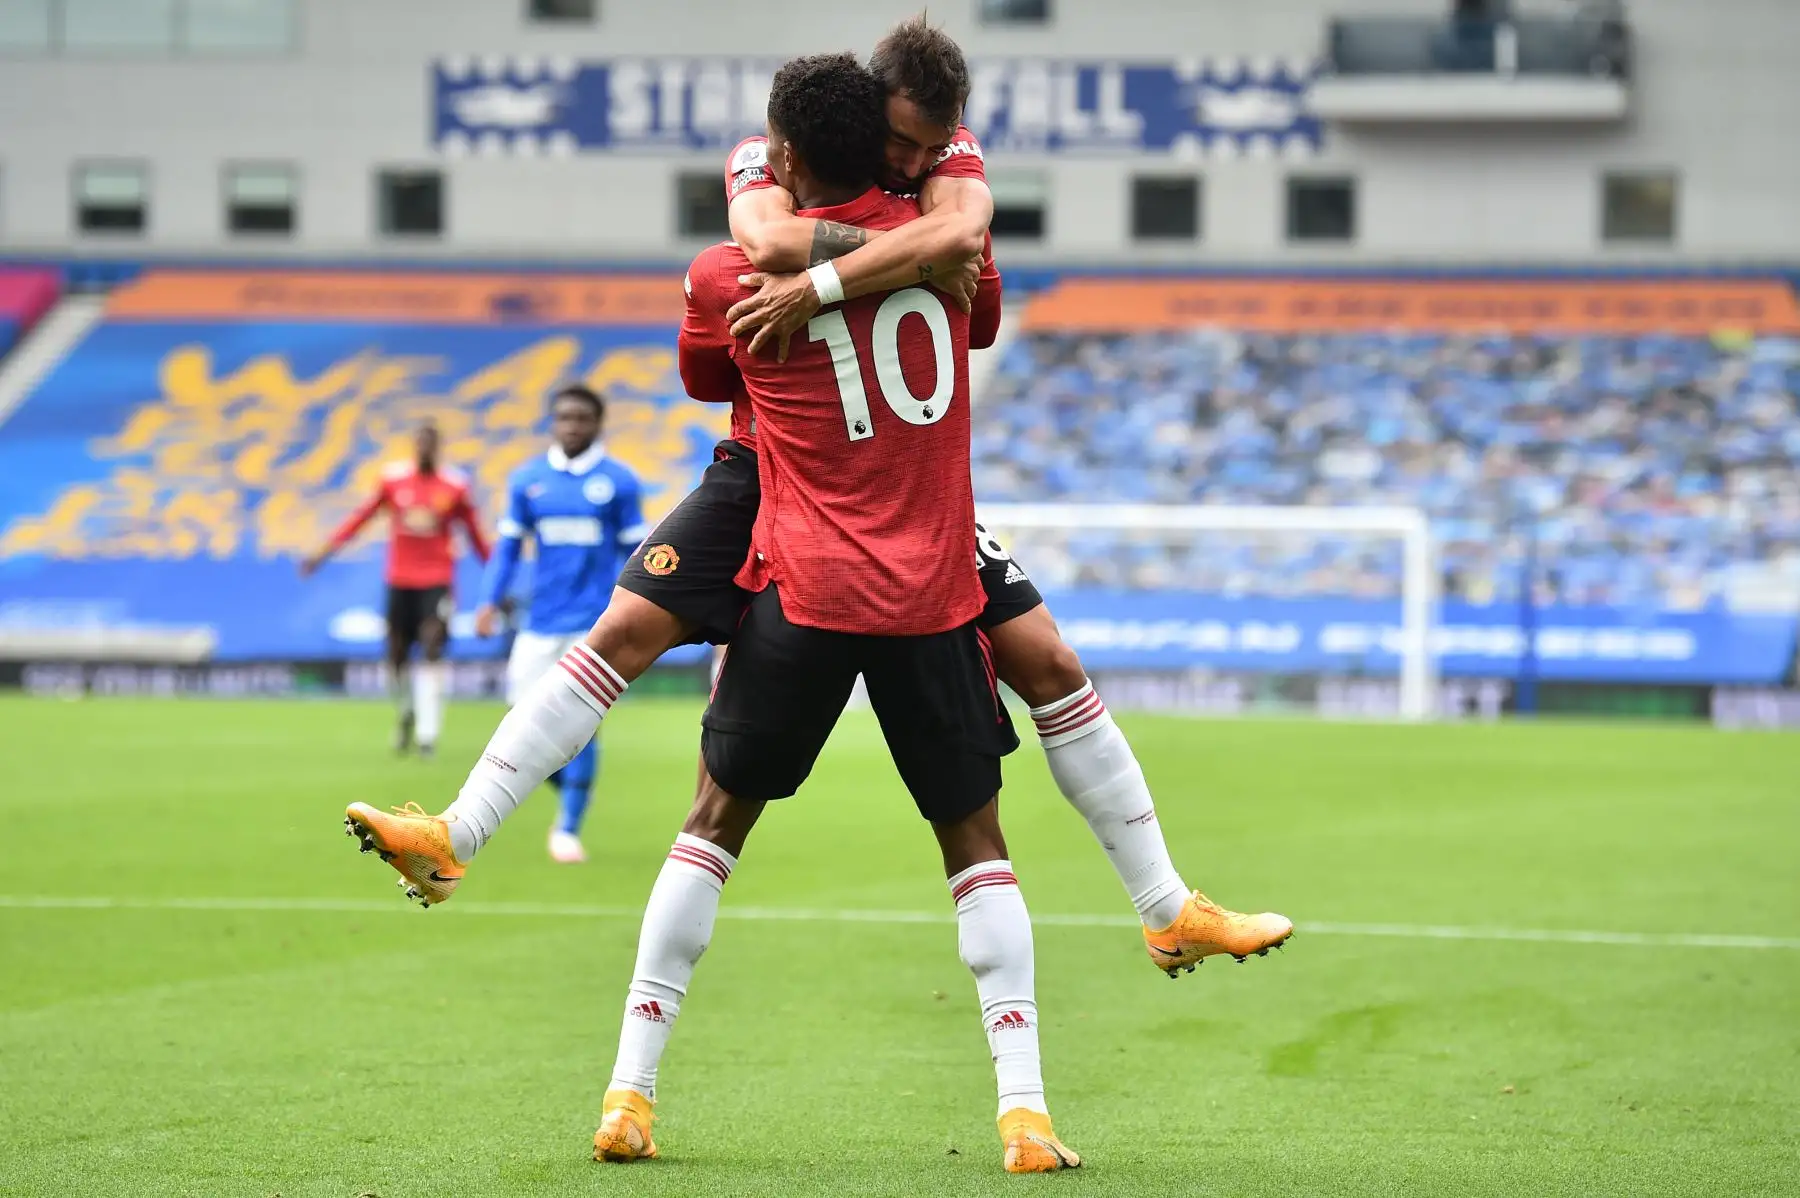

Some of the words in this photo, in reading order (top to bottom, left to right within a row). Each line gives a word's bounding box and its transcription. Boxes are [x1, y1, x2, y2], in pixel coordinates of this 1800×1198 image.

[609, 60, 771, 140] STAN
[969, 60, 1146, 140] FALL
[808, 287, 955, 441] 10
[975, 521, 1011, 570] 8
[629, 1008, 668, 1024] adidas
[991, 1020, 1030, 1033] adidas
